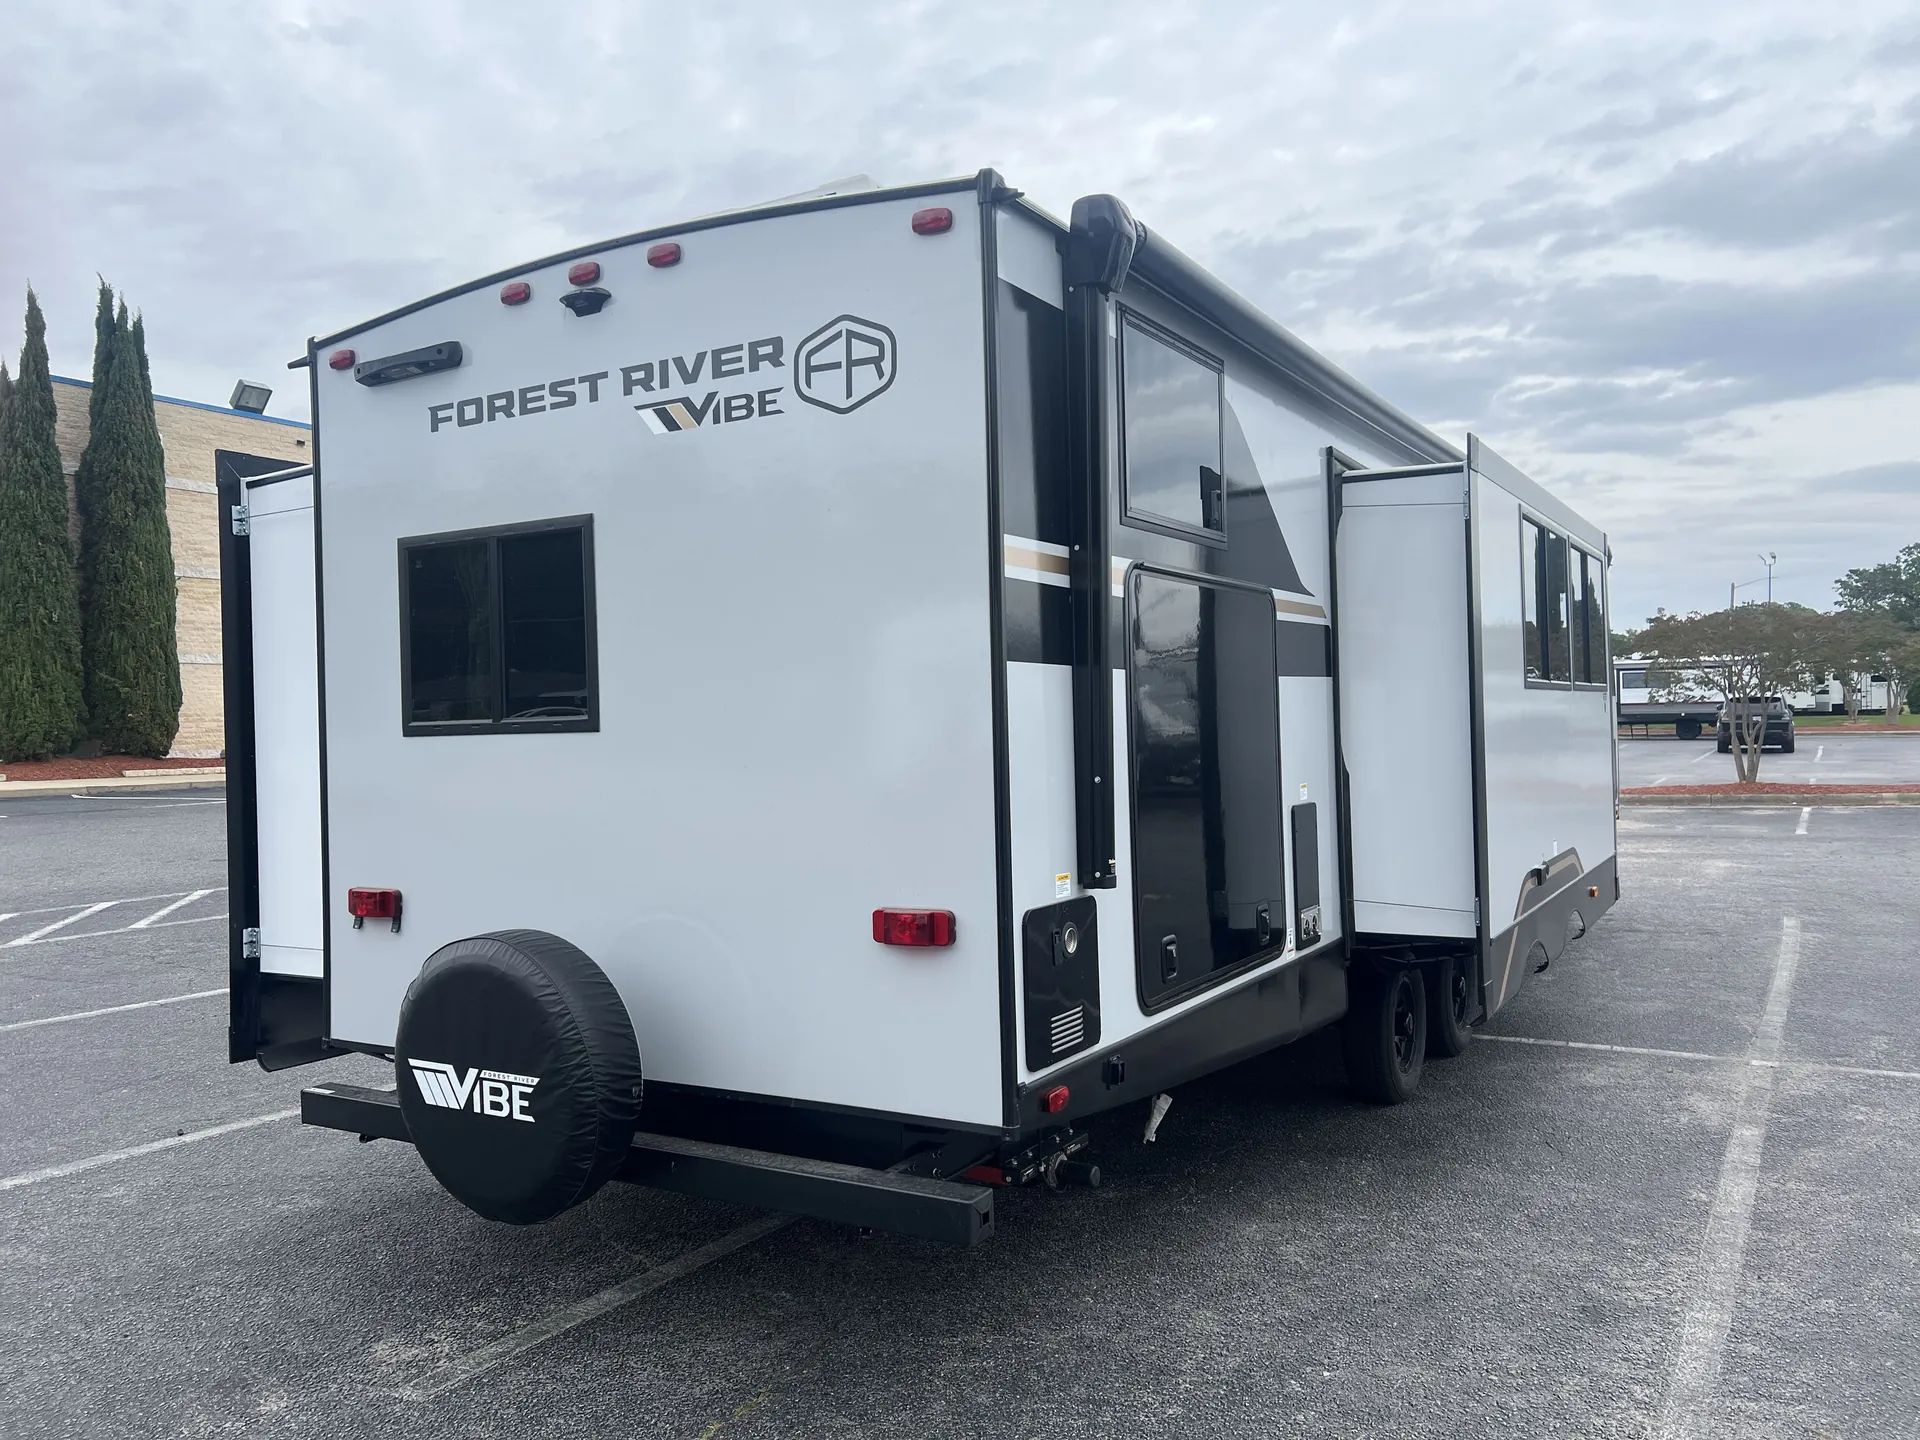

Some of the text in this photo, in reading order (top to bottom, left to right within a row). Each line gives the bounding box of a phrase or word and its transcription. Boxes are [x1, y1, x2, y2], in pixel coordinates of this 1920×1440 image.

[427, 336, 786, 434] FOREST RIVER
[634, 386, 786, 427] VIBE
[407, 1058, 536, 1123] VIBE
[483, 1071, 535, 1084] FOREST RIVER
